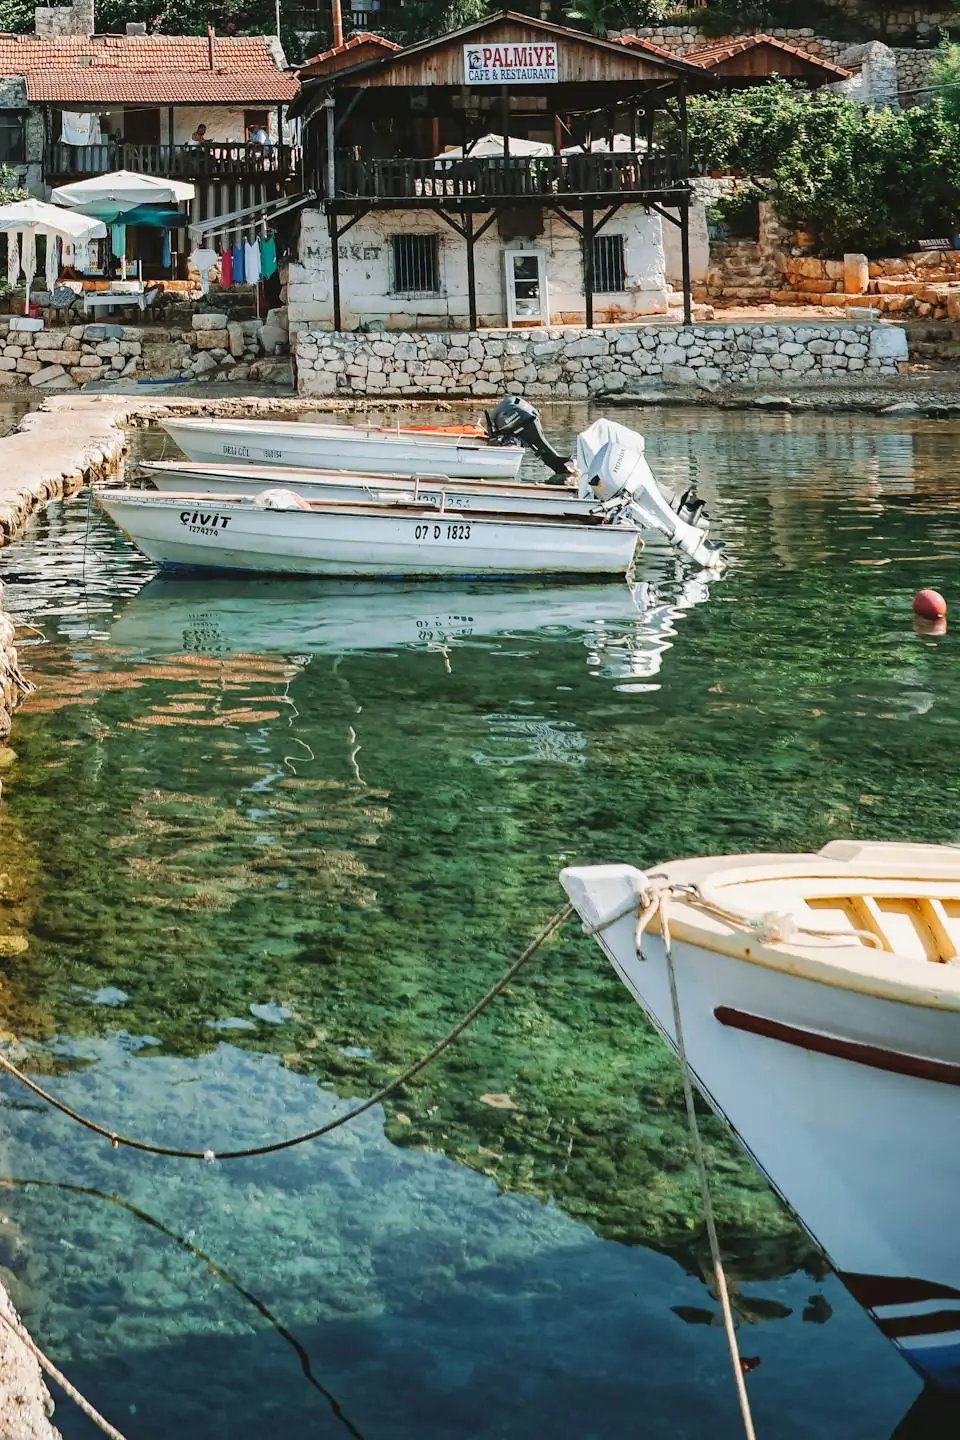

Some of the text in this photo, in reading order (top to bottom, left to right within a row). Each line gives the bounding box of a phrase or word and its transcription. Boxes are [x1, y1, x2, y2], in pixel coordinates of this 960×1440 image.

[468, 68, 556, 81] CAFE & RESTAURANT
[238, 446, 251, 457] GÜL
[414, 525, 471, 540] 07 D 1823
